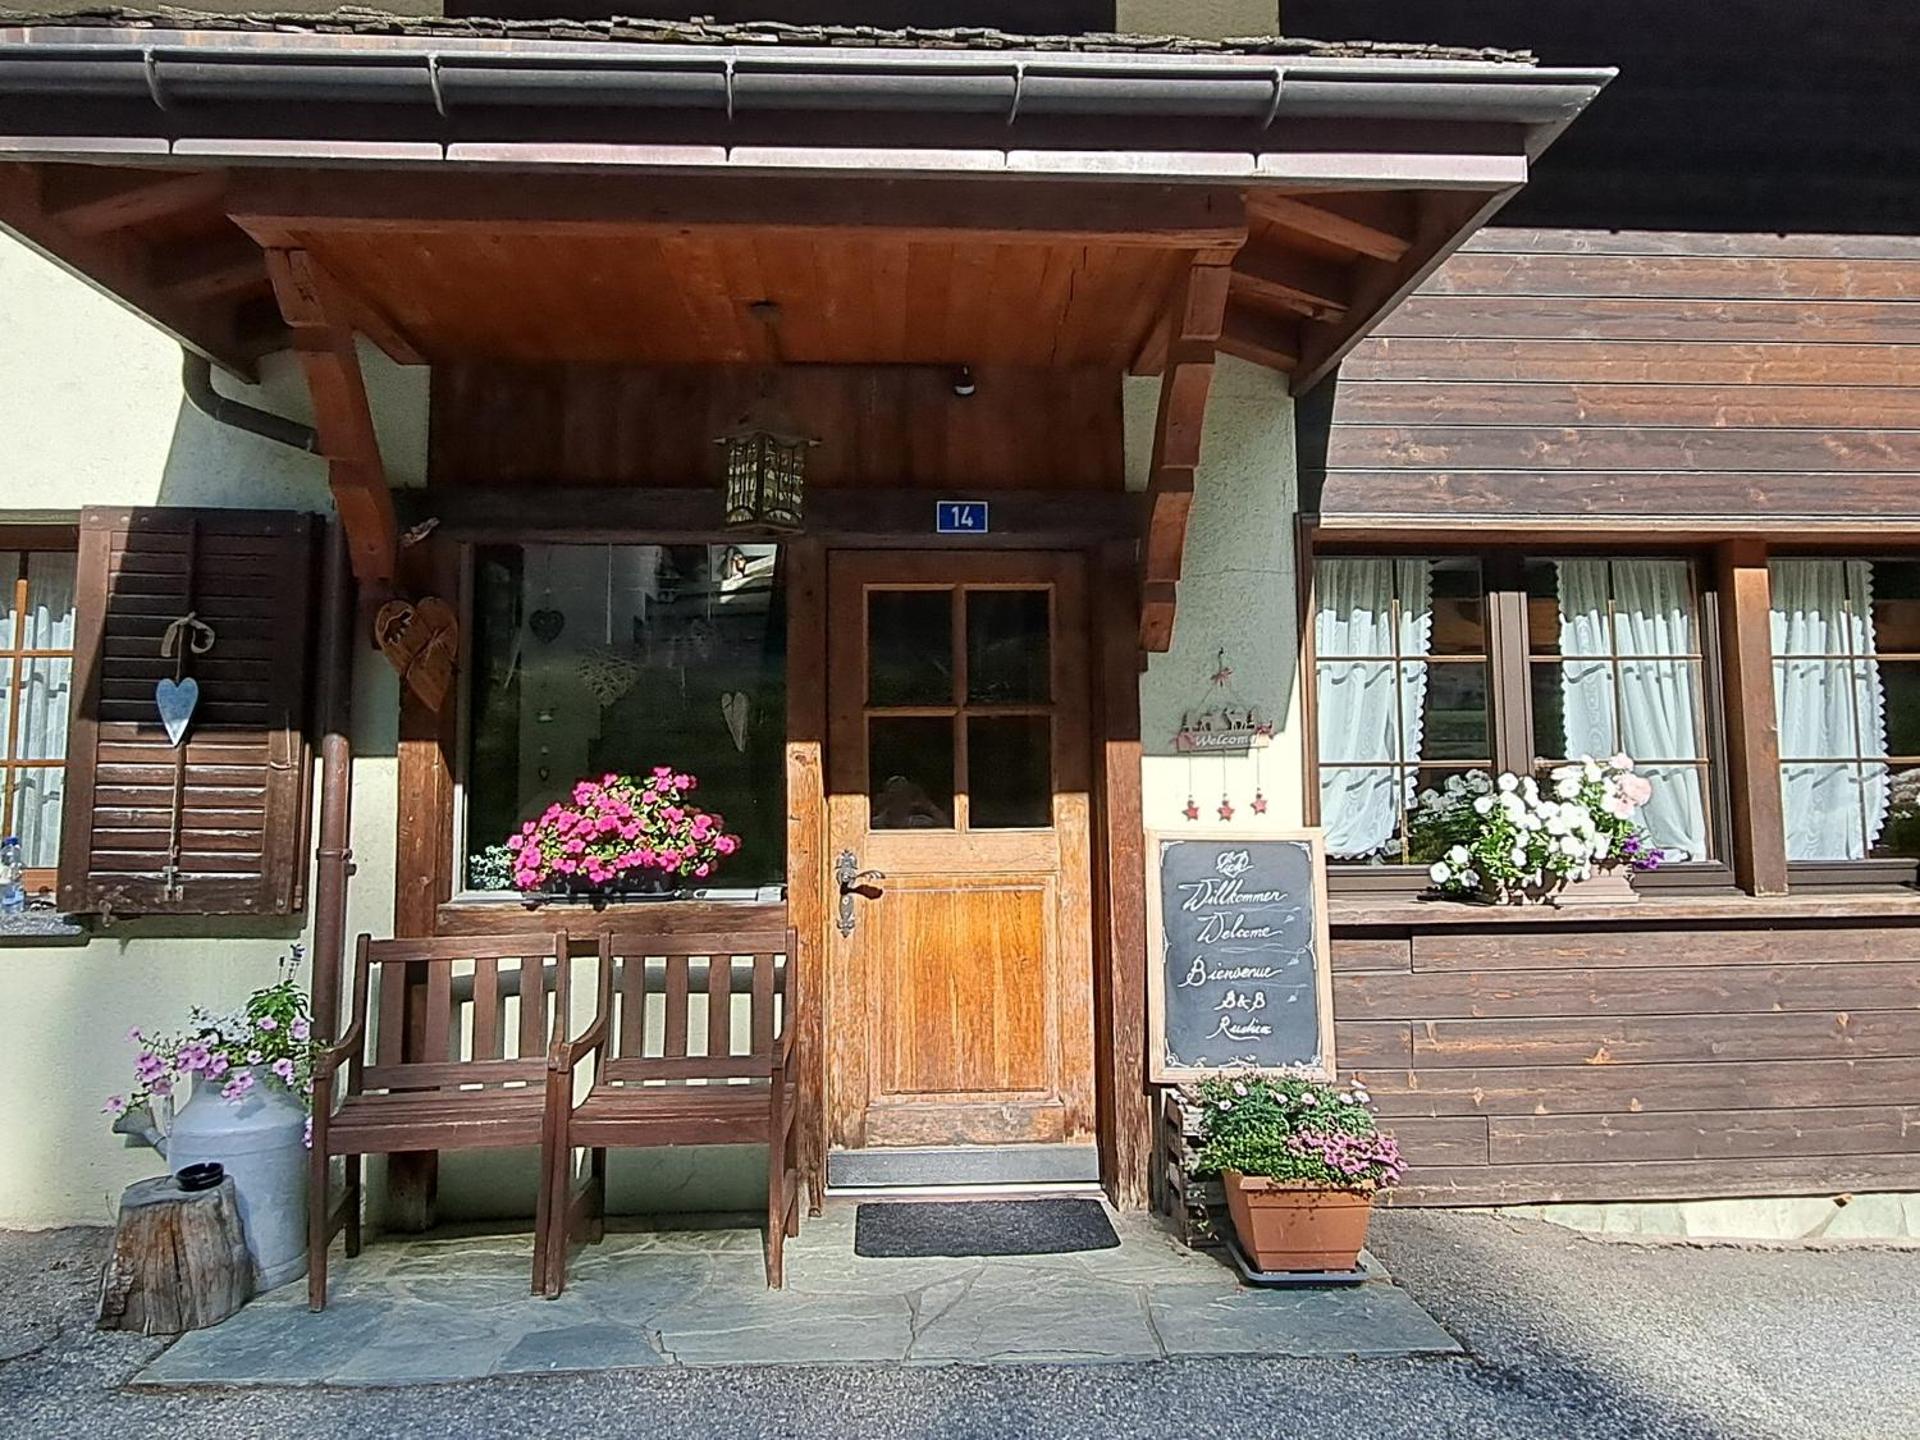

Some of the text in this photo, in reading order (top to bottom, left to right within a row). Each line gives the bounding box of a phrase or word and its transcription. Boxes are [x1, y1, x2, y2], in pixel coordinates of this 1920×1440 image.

[951, 505, 974, 528] 14
[1195, 734, 1256, 749] Welcom
[1178, 878, 1288, 912] Willkommen
[1197, 911, 1283, 944] Welcome
[1177, 955, 1283, 988] Bienvenue
